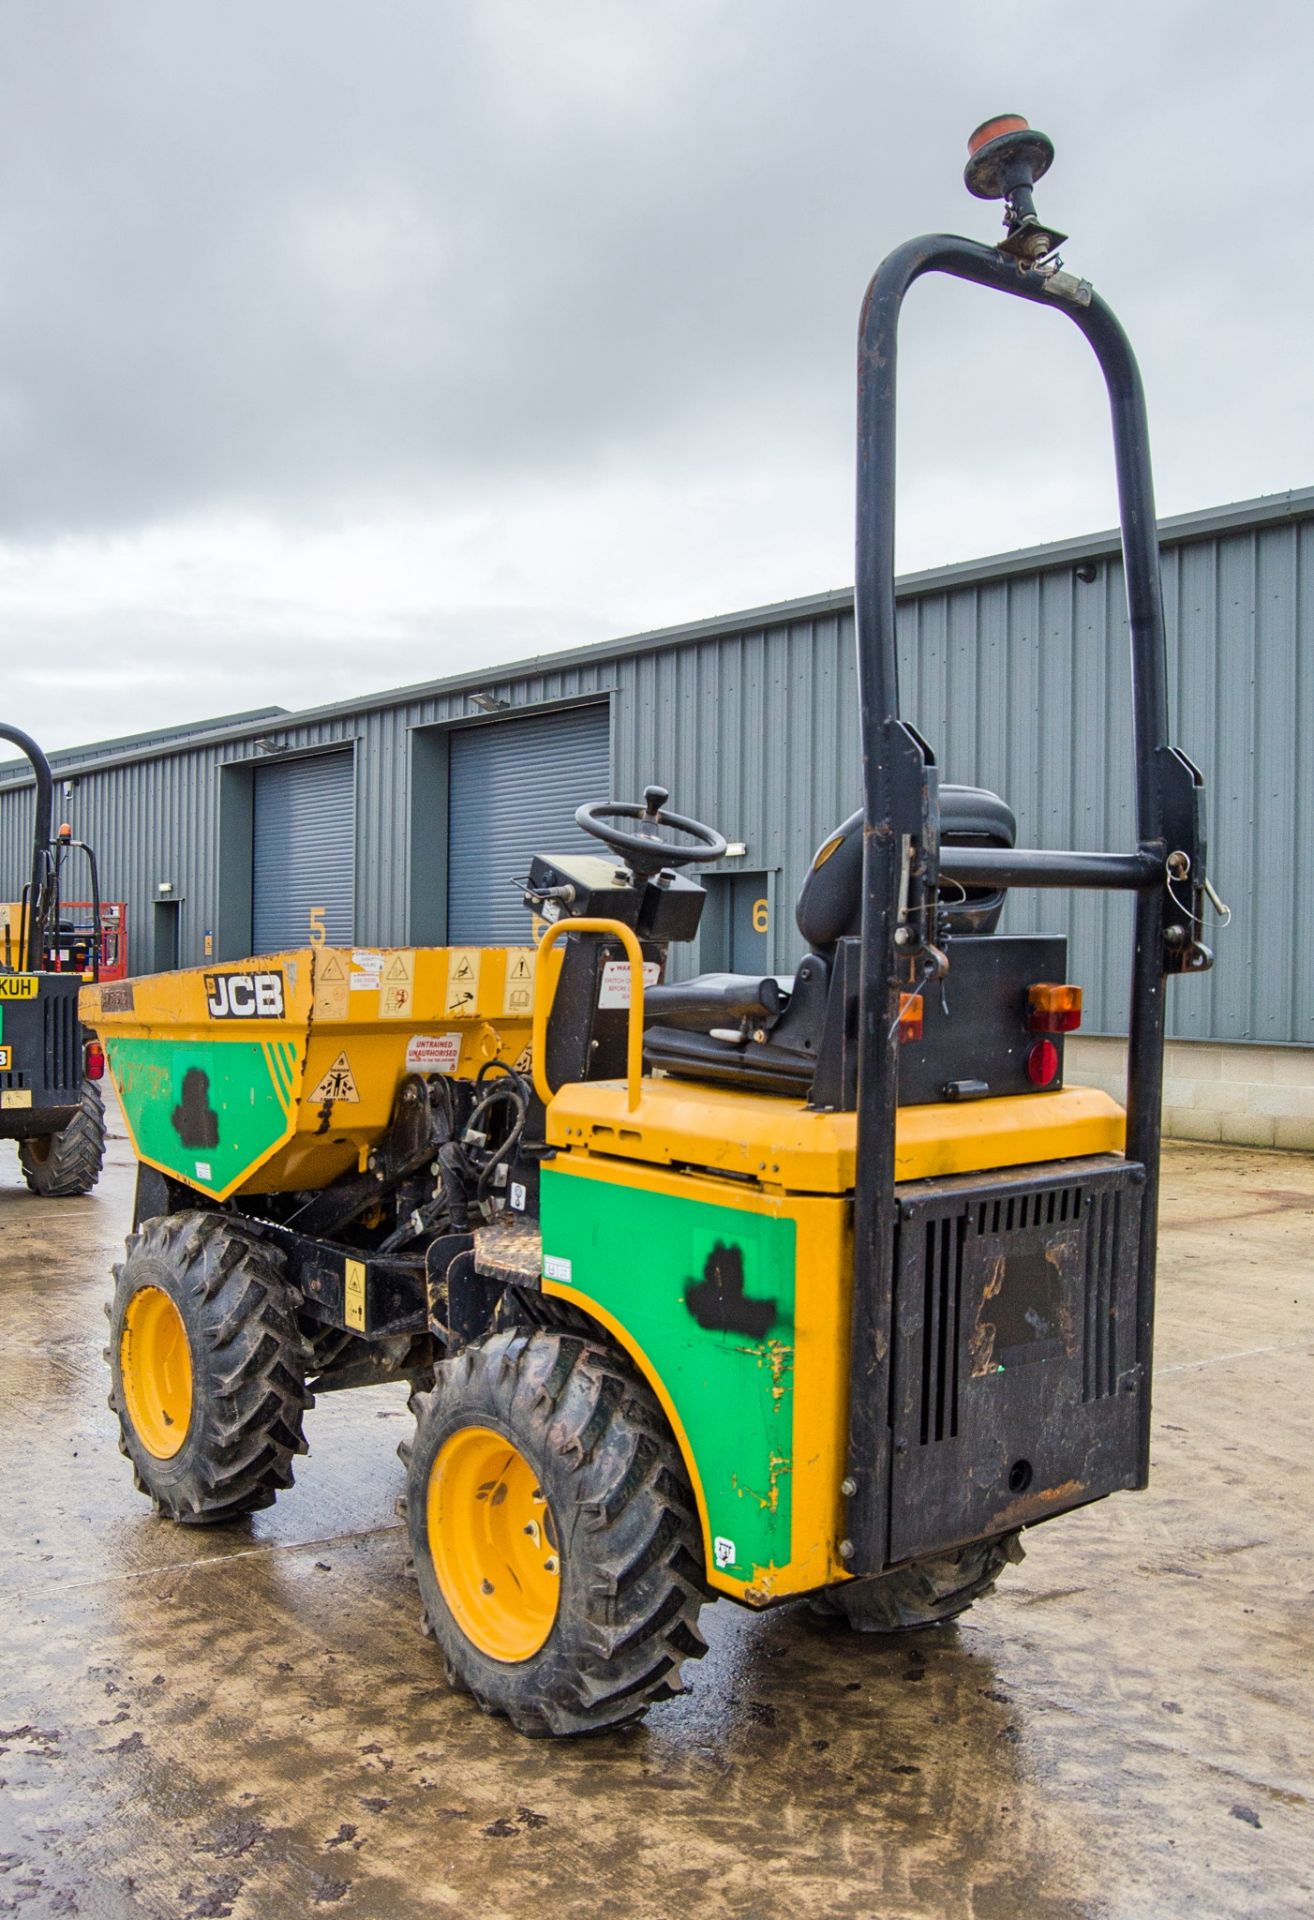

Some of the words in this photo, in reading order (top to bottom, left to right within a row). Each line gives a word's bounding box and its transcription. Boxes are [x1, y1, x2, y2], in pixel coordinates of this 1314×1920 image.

[309, 907, 326, 948] 5
[752, 899, 768, 933] 6
[0, 979, 31, 995] KUH
[208, 975, 284, 1016] JCB
